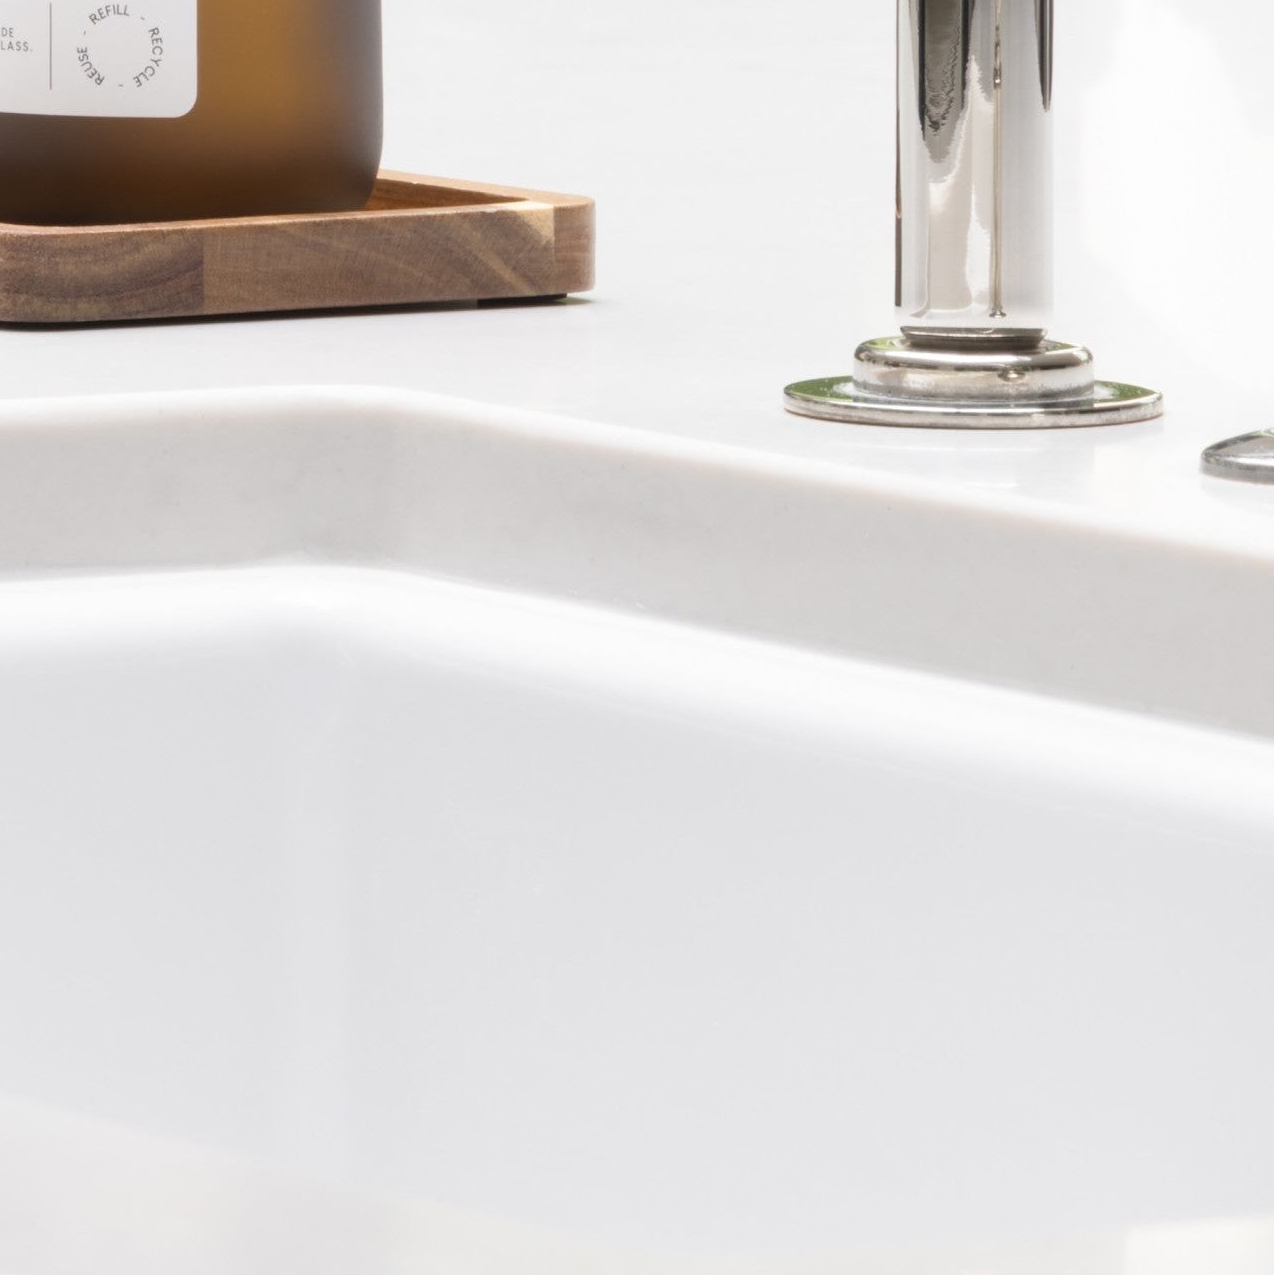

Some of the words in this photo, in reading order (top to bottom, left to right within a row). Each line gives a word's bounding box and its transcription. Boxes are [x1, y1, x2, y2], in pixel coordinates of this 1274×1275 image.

[88, 3, 130, 25] REFILL
[77, 46, 105, 87] REUSE
[133, 26, 163, 88] RECYCLE
